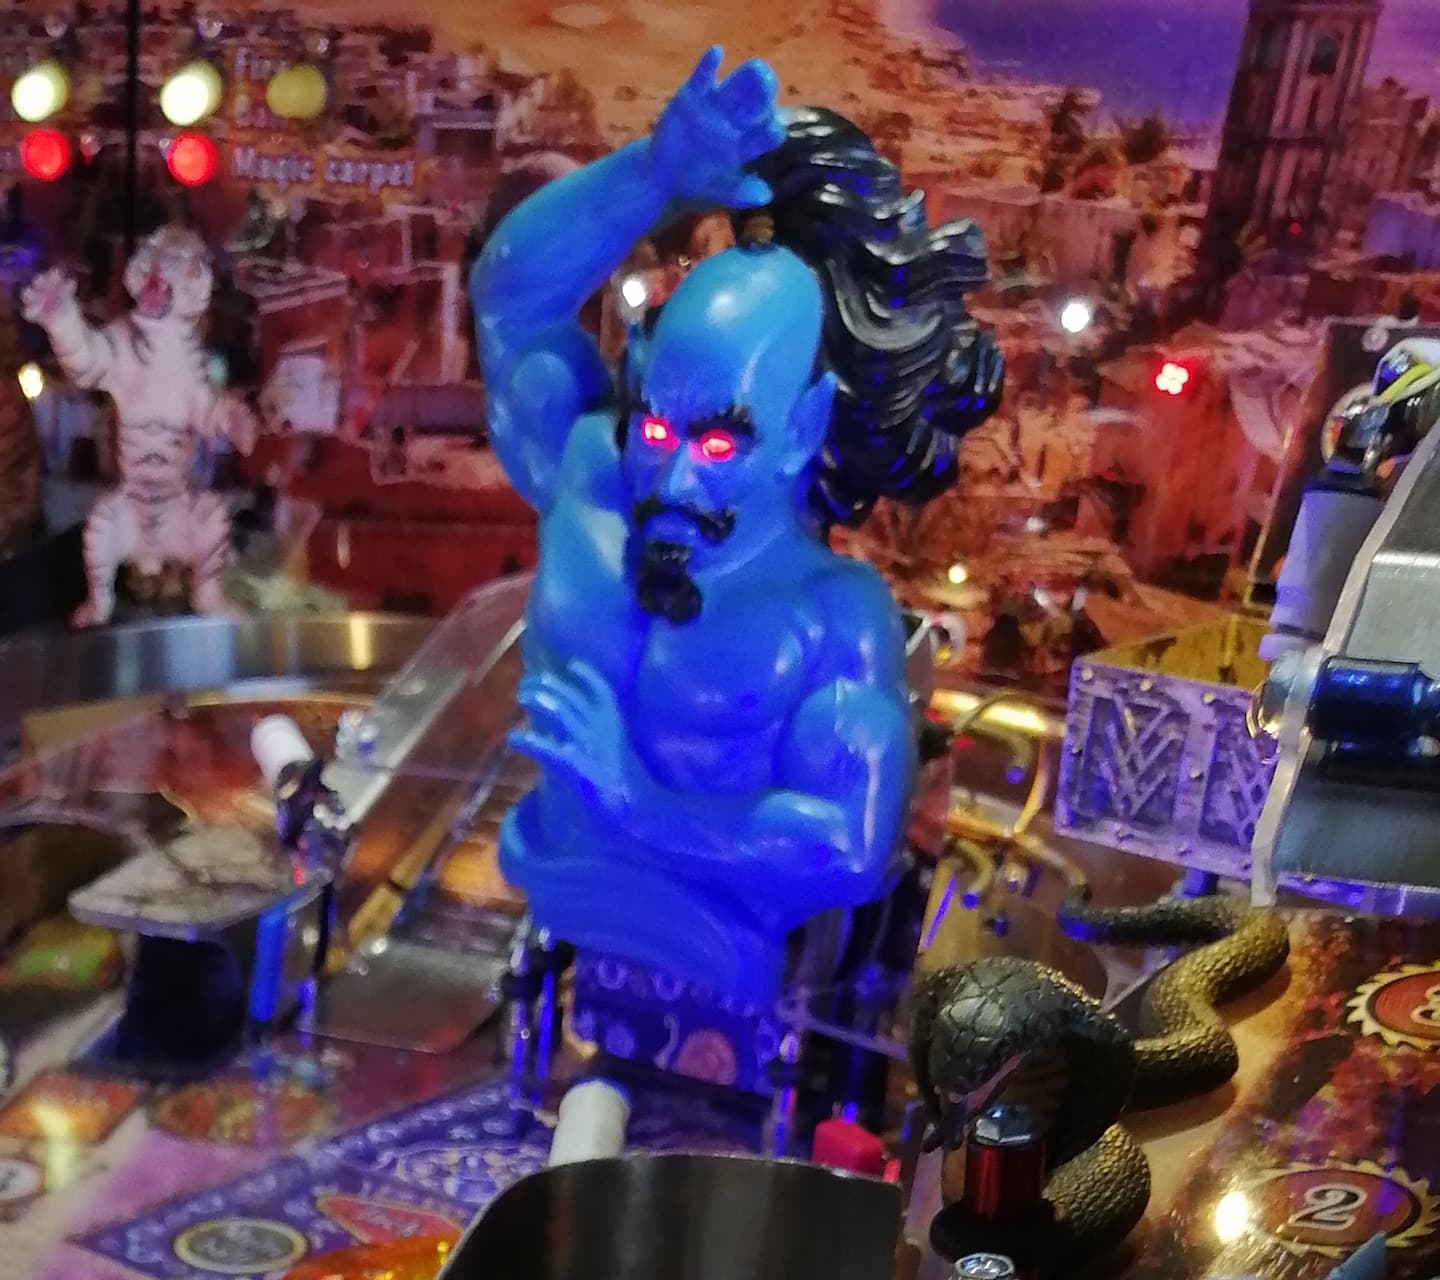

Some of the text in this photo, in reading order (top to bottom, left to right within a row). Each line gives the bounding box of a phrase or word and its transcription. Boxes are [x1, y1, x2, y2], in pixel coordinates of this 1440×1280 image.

[234, 146, 416, 196] Magic carpet
[1287, 1183, 1368, 1231] 2
